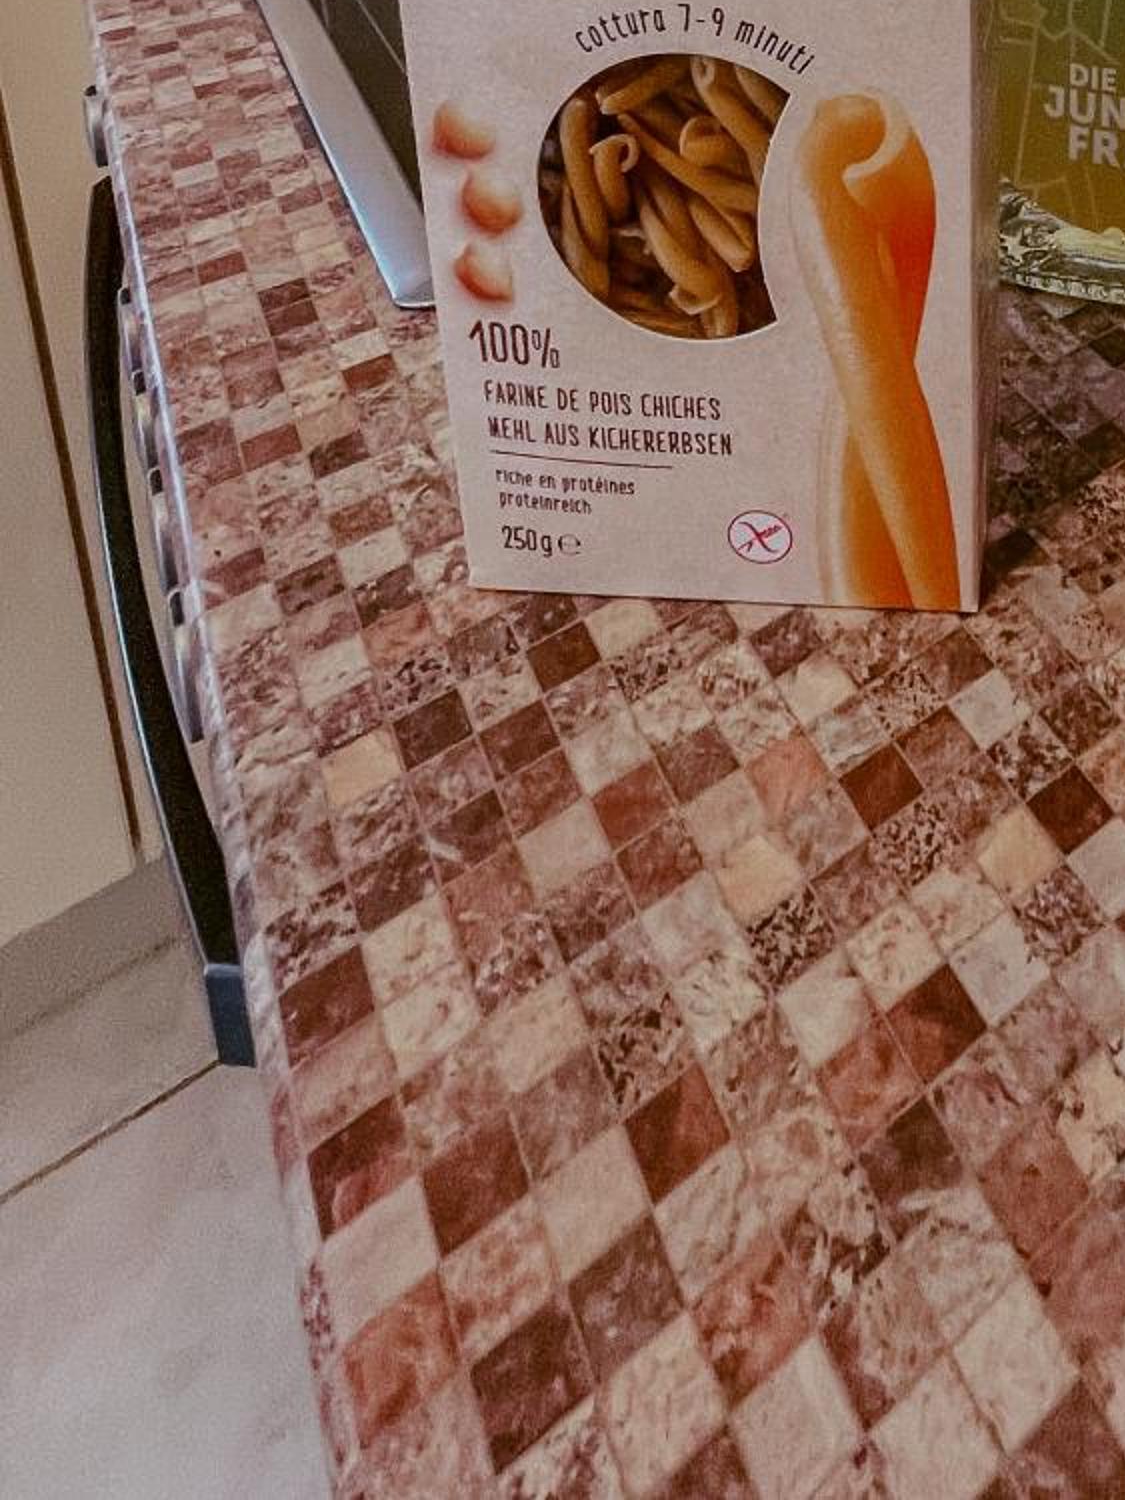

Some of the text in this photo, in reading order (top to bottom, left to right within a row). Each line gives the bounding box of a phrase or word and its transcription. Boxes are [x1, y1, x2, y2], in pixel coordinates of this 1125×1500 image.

[575, 3, 817, 75] cottura 7-9 minuti
[1069, 63, 1117, 93] DIE
[468, 320, 561, 370] 100%
[483, 379, 721, 421] FARINE DE POIS CHICHES
[487, 416, 733, 456] MEHL AUS KICHERERBSEN
[495, 468, 533, 487] riche
[539, 475, 556, 490] en
